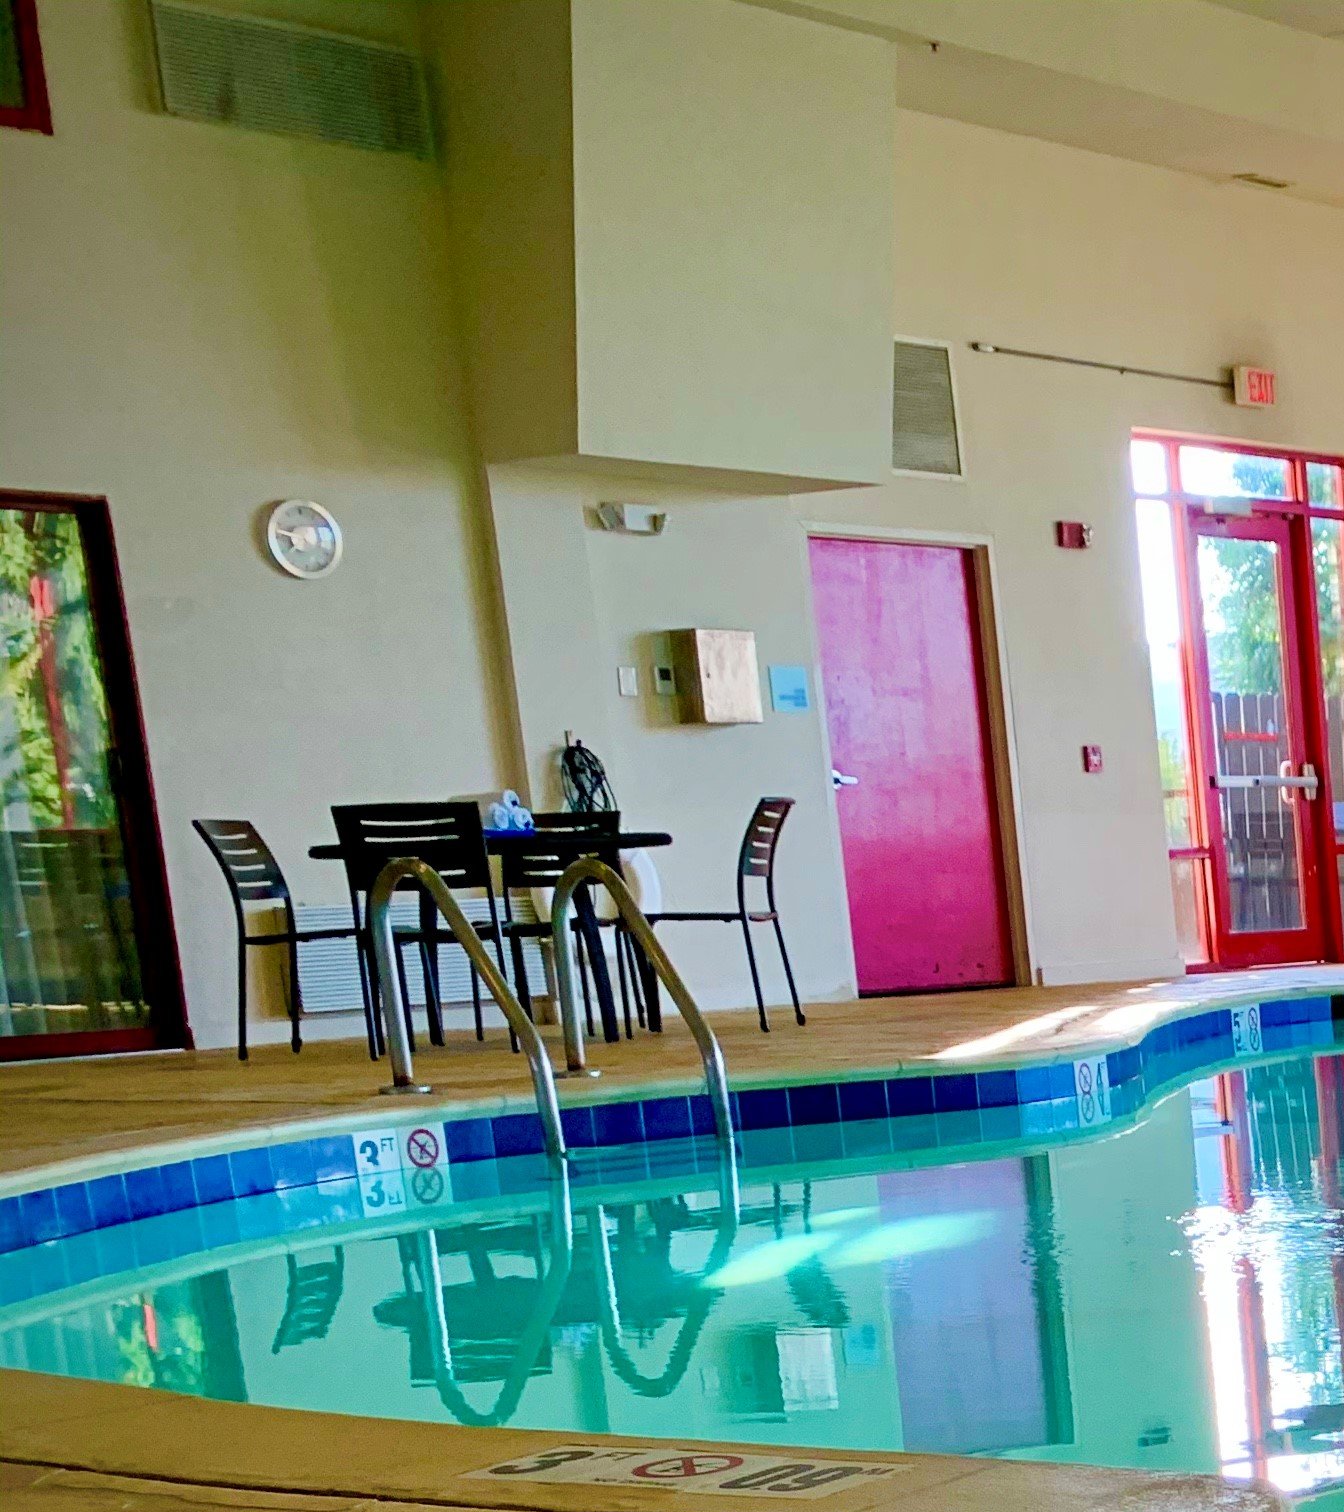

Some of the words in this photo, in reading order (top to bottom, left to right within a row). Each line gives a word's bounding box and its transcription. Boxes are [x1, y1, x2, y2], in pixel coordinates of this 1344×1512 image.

[1246, 370, 1274, 405] EXIT
[380, 1137, 394, 1152] FT
[488, 1450, 595, 1475] 3
[589, 1451, 648, 1462] FT
